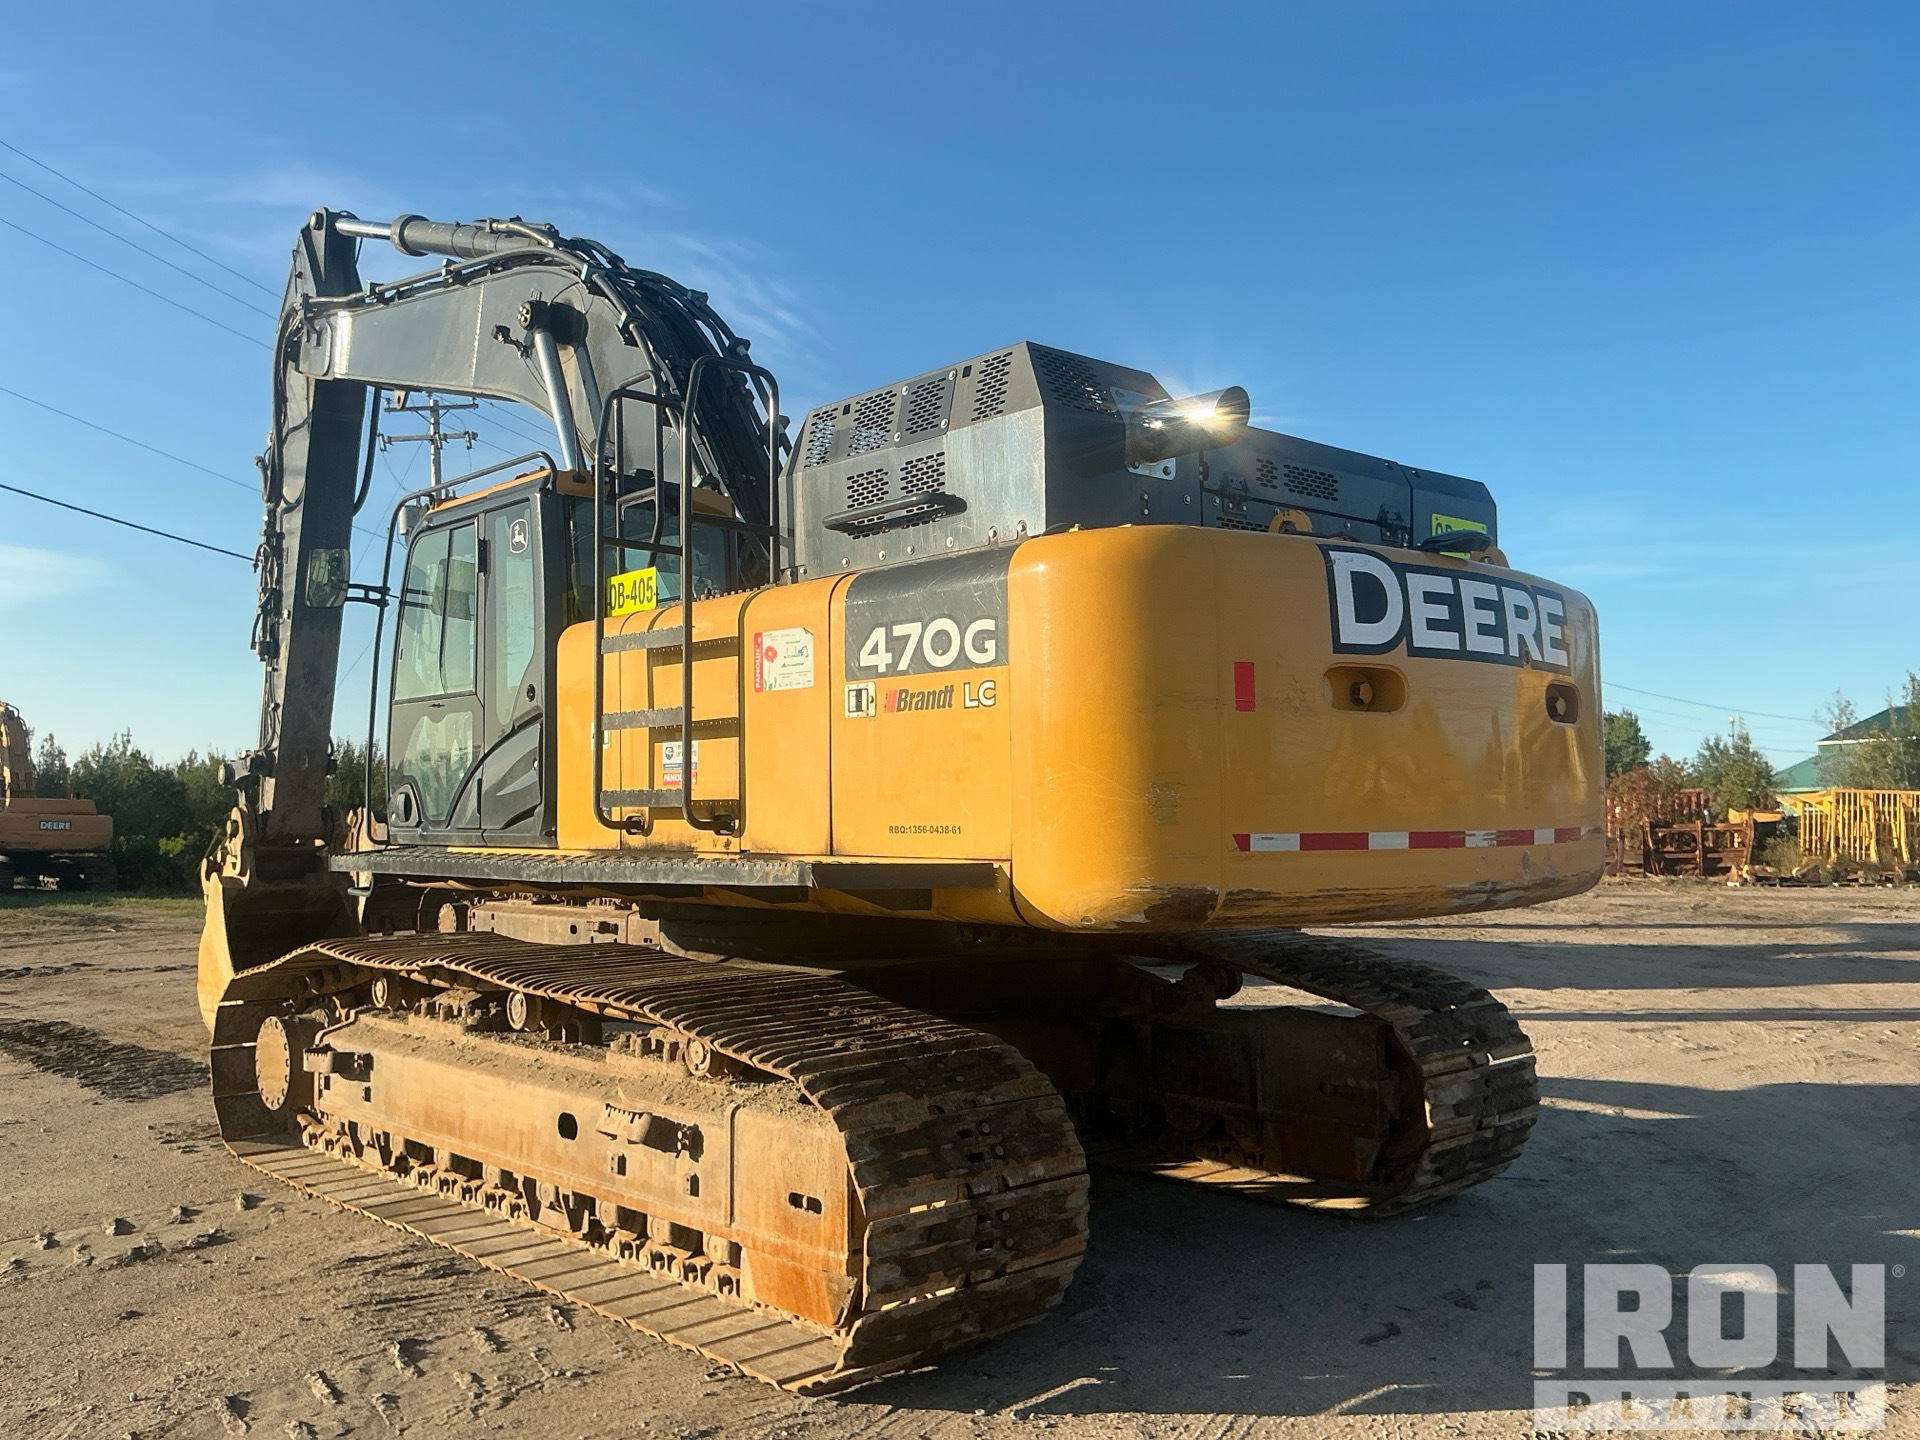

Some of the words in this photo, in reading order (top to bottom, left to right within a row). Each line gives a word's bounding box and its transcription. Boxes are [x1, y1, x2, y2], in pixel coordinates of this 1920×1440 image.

[1328, 550, 1569, 668] DEERE
[859, 617, 996, 673] 470G
[896, 684, 955, 713] Brandt
[963, 679, 997, 710] LC
[40, 821, 71, 830] DEERE
[888, 825, 962, 834] RBQ:1356-0438-61
